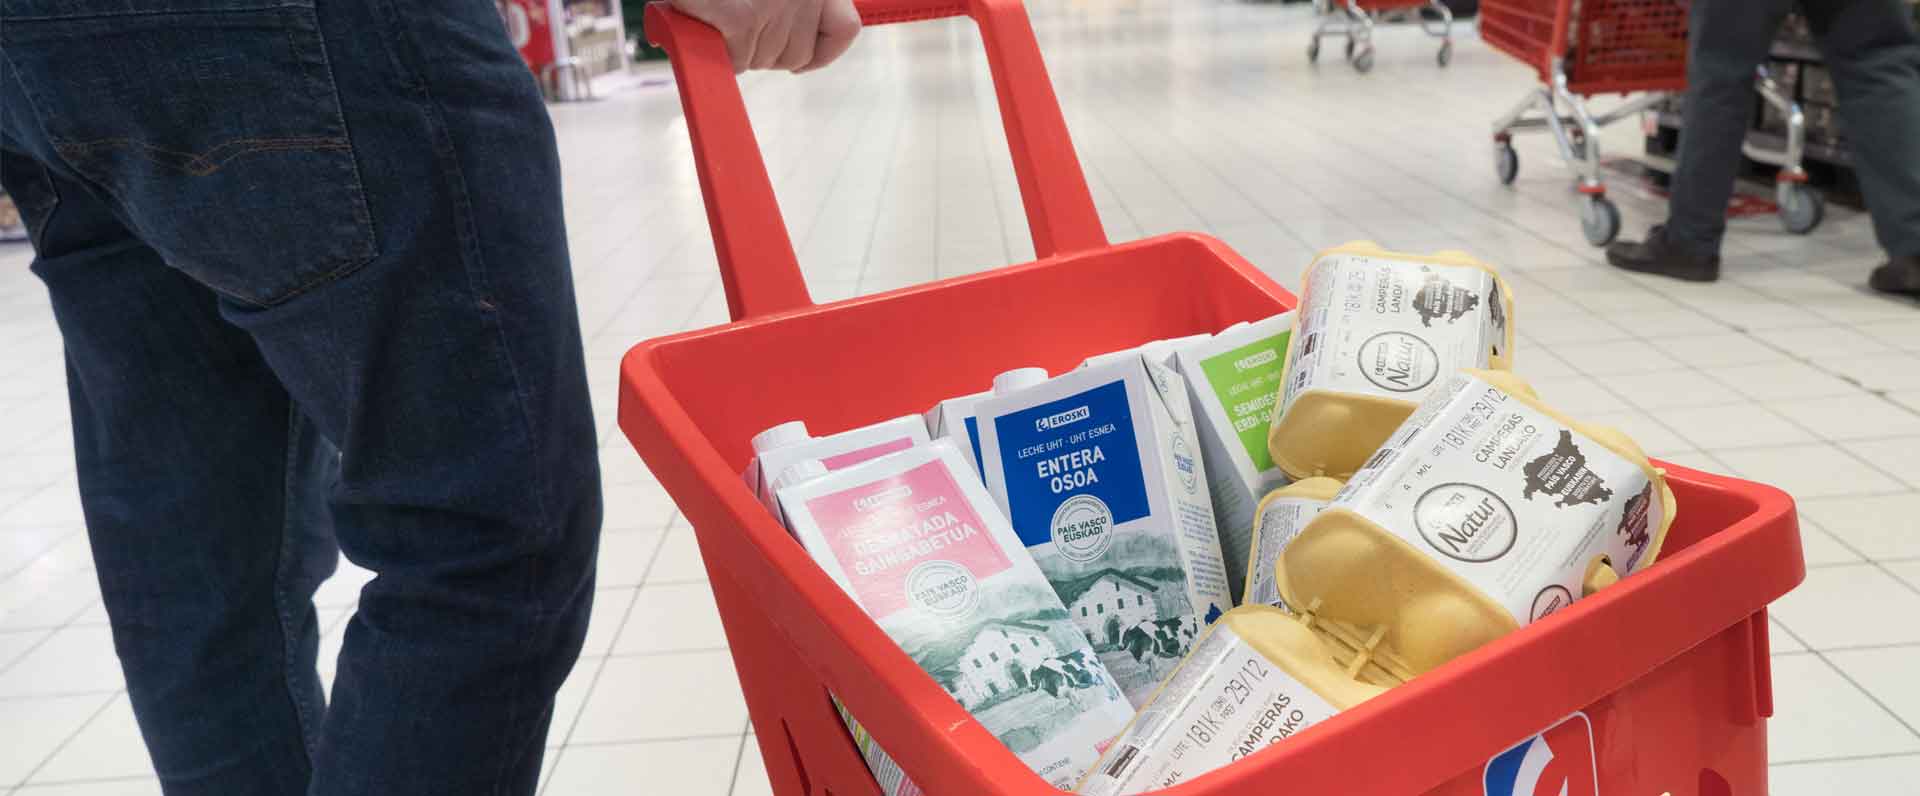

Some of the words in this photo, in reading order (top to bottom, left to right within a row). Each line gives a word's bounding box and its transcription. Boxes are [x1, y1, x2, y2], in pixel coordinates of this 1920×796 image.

[1051, 407, 1089, 428] EROSKI
[1471, 388, 1508, 420] 29/12
[1018, 444, 1045, 458] LECHE
[1046, 438, 1063, 451] UHT
[1070, 431, 1087, 445] UHT
[1088, 423, 1116, 439] ESNEA
[1036, 445, 1105, 478] ENTERA
[1051, 467, 1099, 494] OSOA
[855, 511, 960, 554] DEATADA
[1064, 526, 1104, 543] EUSKADI
[1078, 516, 1107, 530] VASCO
[1438, 497, 1496, 552] Natur
[1187, 711, 1221, 750] 181K
[1224, 658, 1269, 705] 29/12
